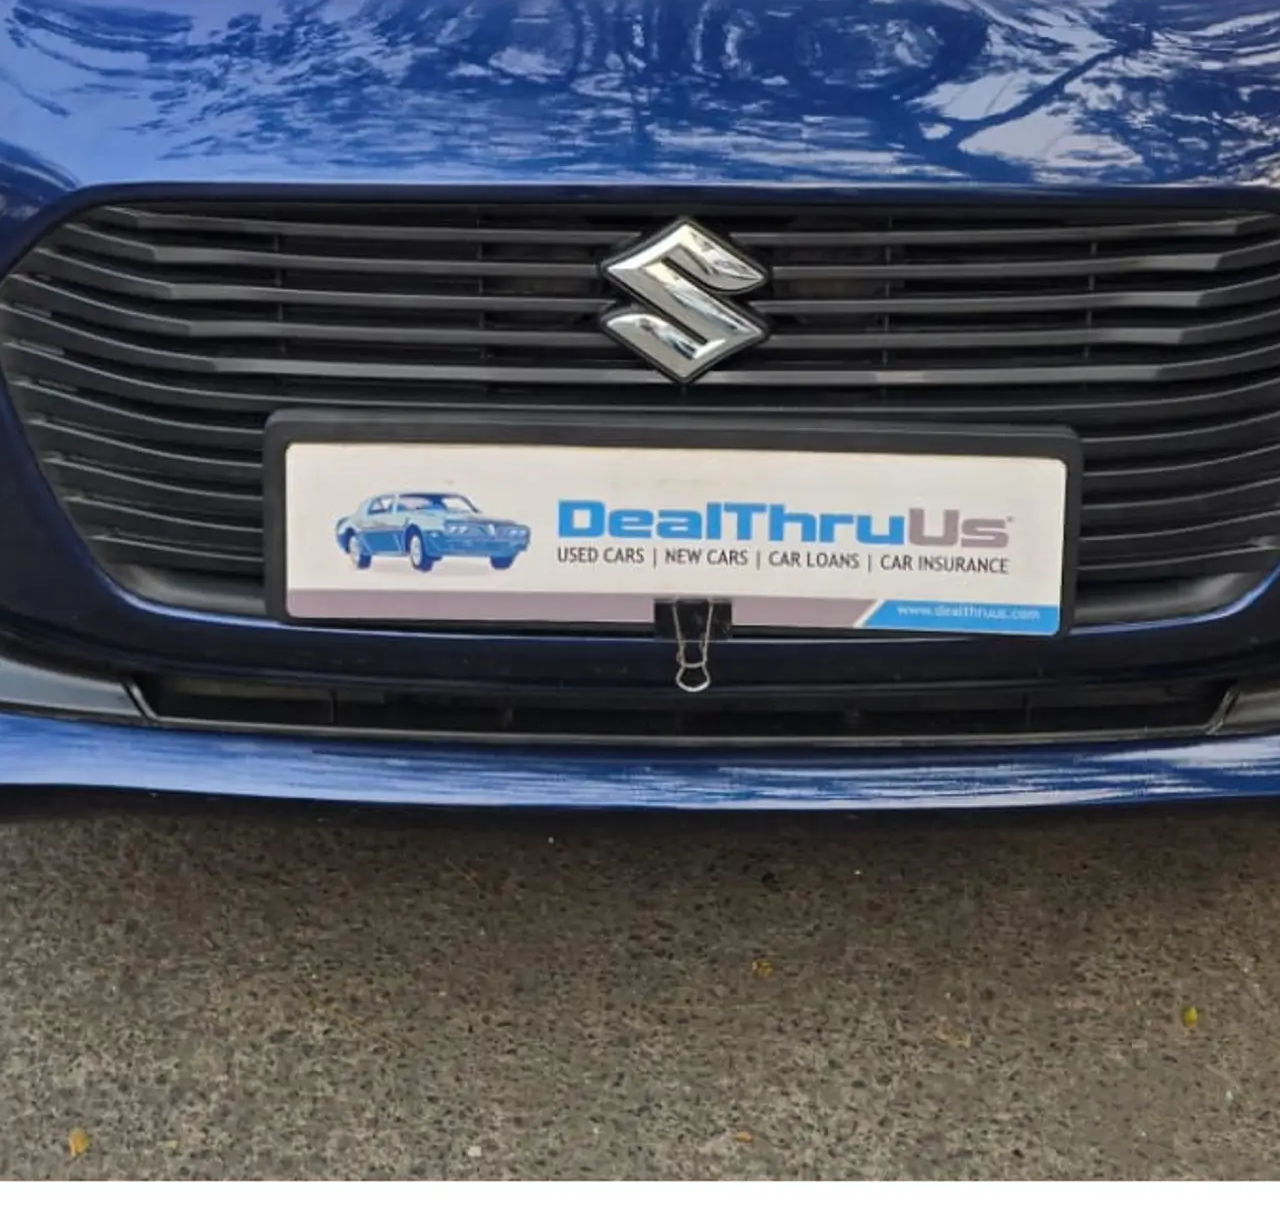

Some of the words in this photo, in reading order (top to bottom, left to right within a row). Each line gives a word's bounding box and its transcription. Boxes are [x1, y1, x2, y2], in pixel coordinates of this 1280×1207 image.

[557, 499, 1010, 549] DealThruUs
[557, 546, 599, 564] USED
[603, 547, 645, 564] CARS
[665, 548, 702, 565] NEW
[706, 549, 748, 566] CARS
[769, 551, 801, 568] CAR
[806, 551, 860, 570] LOANS
[880, 554, 913, 571] CAR
[919, 555, 1010, 574] INSURANCE
